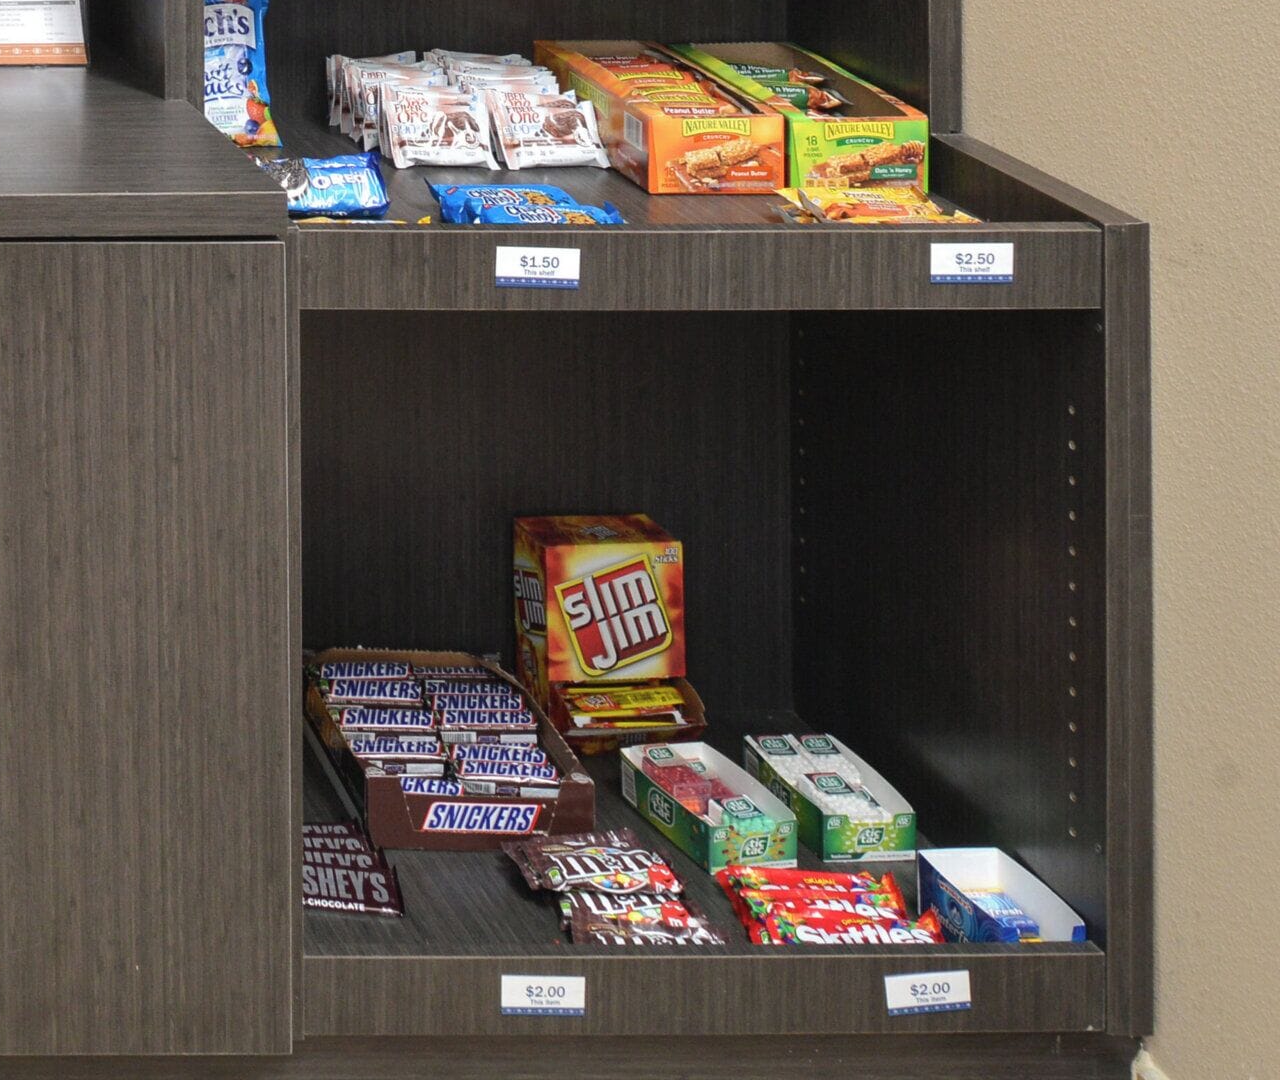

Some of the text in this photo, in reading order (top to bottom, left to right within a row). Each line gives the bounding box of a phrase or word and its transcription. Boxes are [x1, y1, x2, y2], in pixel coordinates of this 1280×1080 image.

[685, 119, 749, 134] NATURE VALLEY
[827, 125, 893, 138] NATURE VALLEY
[806, 136, 818, 147] 18
[520, 256, 560, 268] $1.50
[955, 252, 996, 266] $2.50
[323, 663, 409, 679] SNICKERS
[334, 680, 421, 700] SNICKERS
[435, 694, 521, 710] SNICKERS
[345, 709, 433, 726] SNICKERS
[445, 711, 533, 724] SNICKERS
[456, 745, 545, 764] SNICKERS
[427, 804, 535, 831] SNICKERS
[865, 828, 881, 838] tic
[749, 836, 766, 848] tic
[744, 846, 765, 856] tac
[303, 866, 390, 904] SHEY'S
[307, 899, 365, 913] CHOCOLATE
[795, 924, 935, 944] Skittles
[525, 985, 566, 998] $2.00
[910, 981, 951, 996] $2.00
